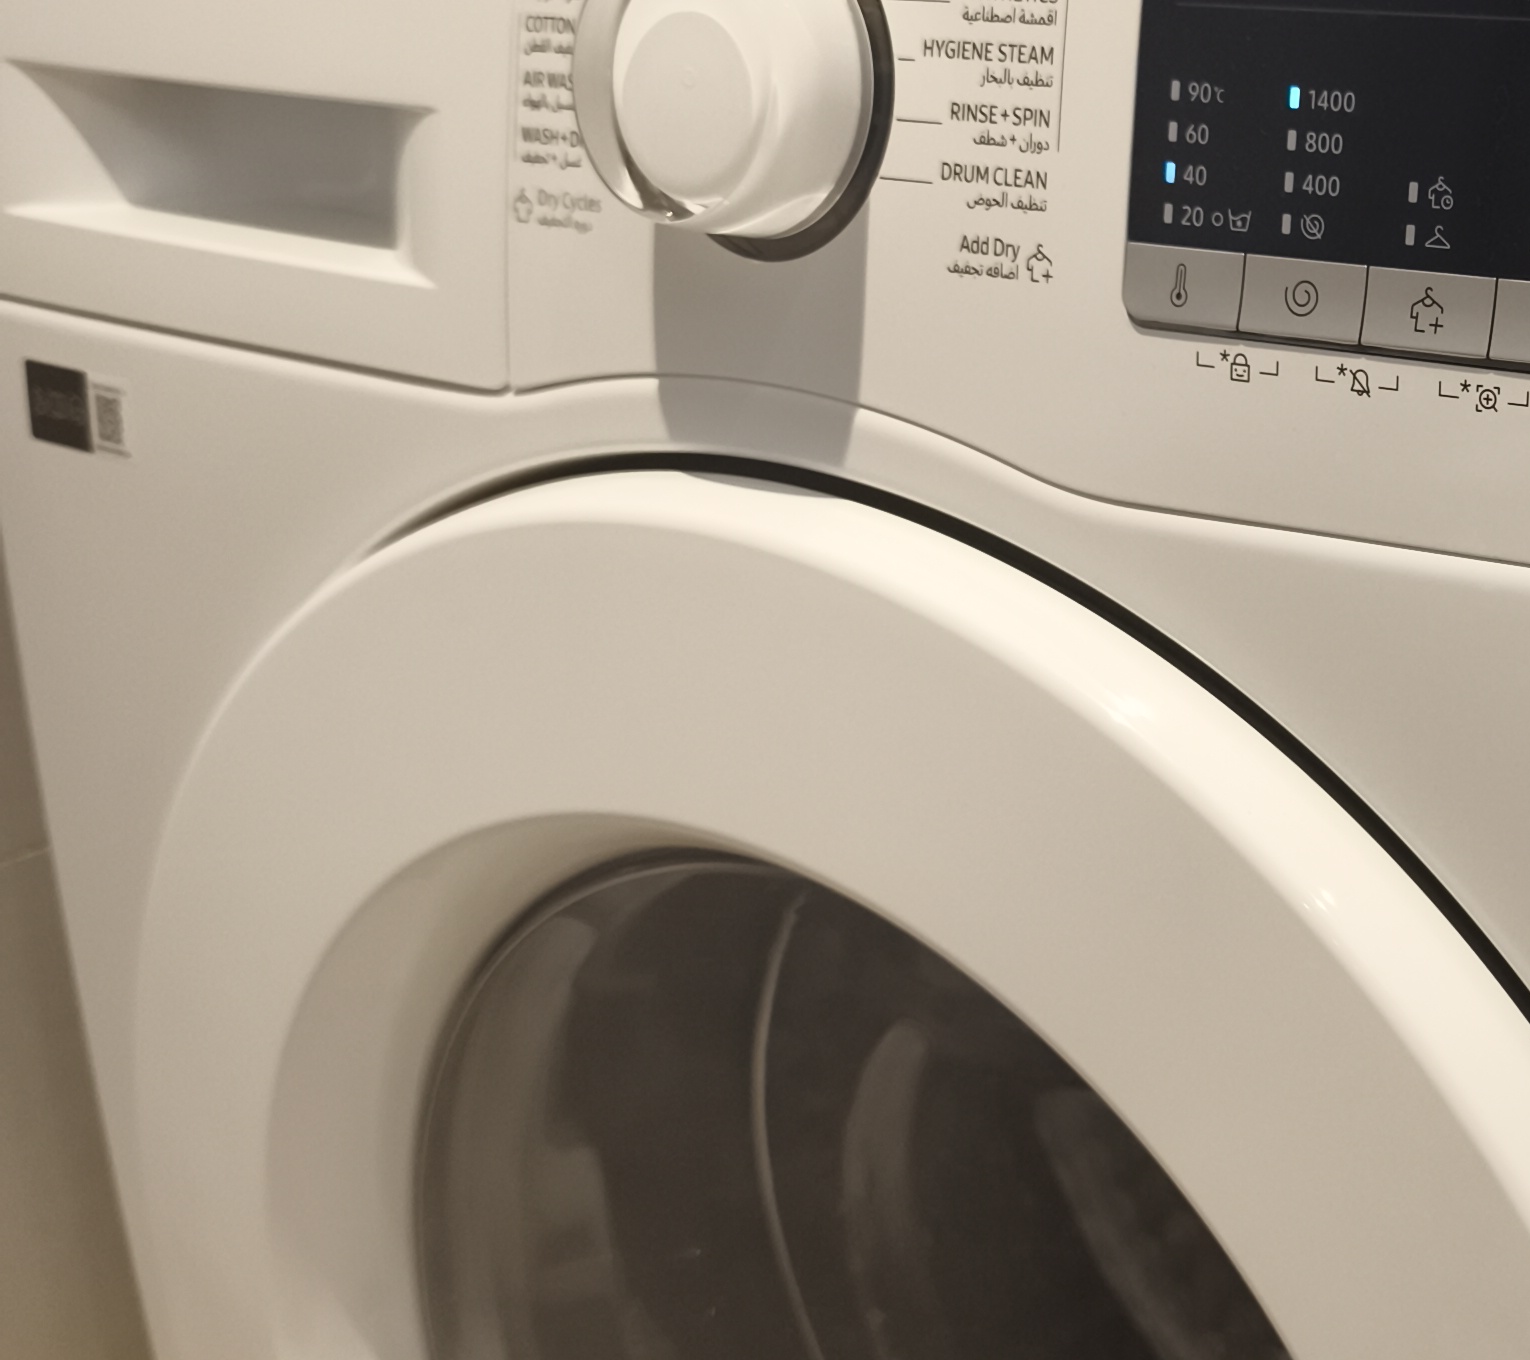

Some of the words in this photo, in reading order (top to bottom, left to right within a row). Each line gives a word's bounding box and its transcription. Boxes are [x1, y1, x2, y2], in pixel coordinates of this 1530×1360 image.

[525, 16, 577, 35] COTTON
[923, 39, 994, 61] HYGIENE
[998, 43, 1055, 65] STEAM
[523, 71, 545, 87] AIR
[548, 73, 574, 91] WAS
[1016, 70, 1053, 90] تنظيف
[1308, 90, 1356, 112] 1400
[1185, 124, 1209, 145] 60
[1305, 131, 1343, 154] 800
[941, 162, 989, 184] DRUM
[993, 167, 1048, 190] CLEAN
[1183, 164, 1207, 186] 40
[1302, 174, 1340, 196] 400
[1011, 195, 1047, 214] تنظيف
[1181, 205, 1204, 227] 20
[959, 235, 989, 255] Add
[994, 239, 1020, 262] Dry
